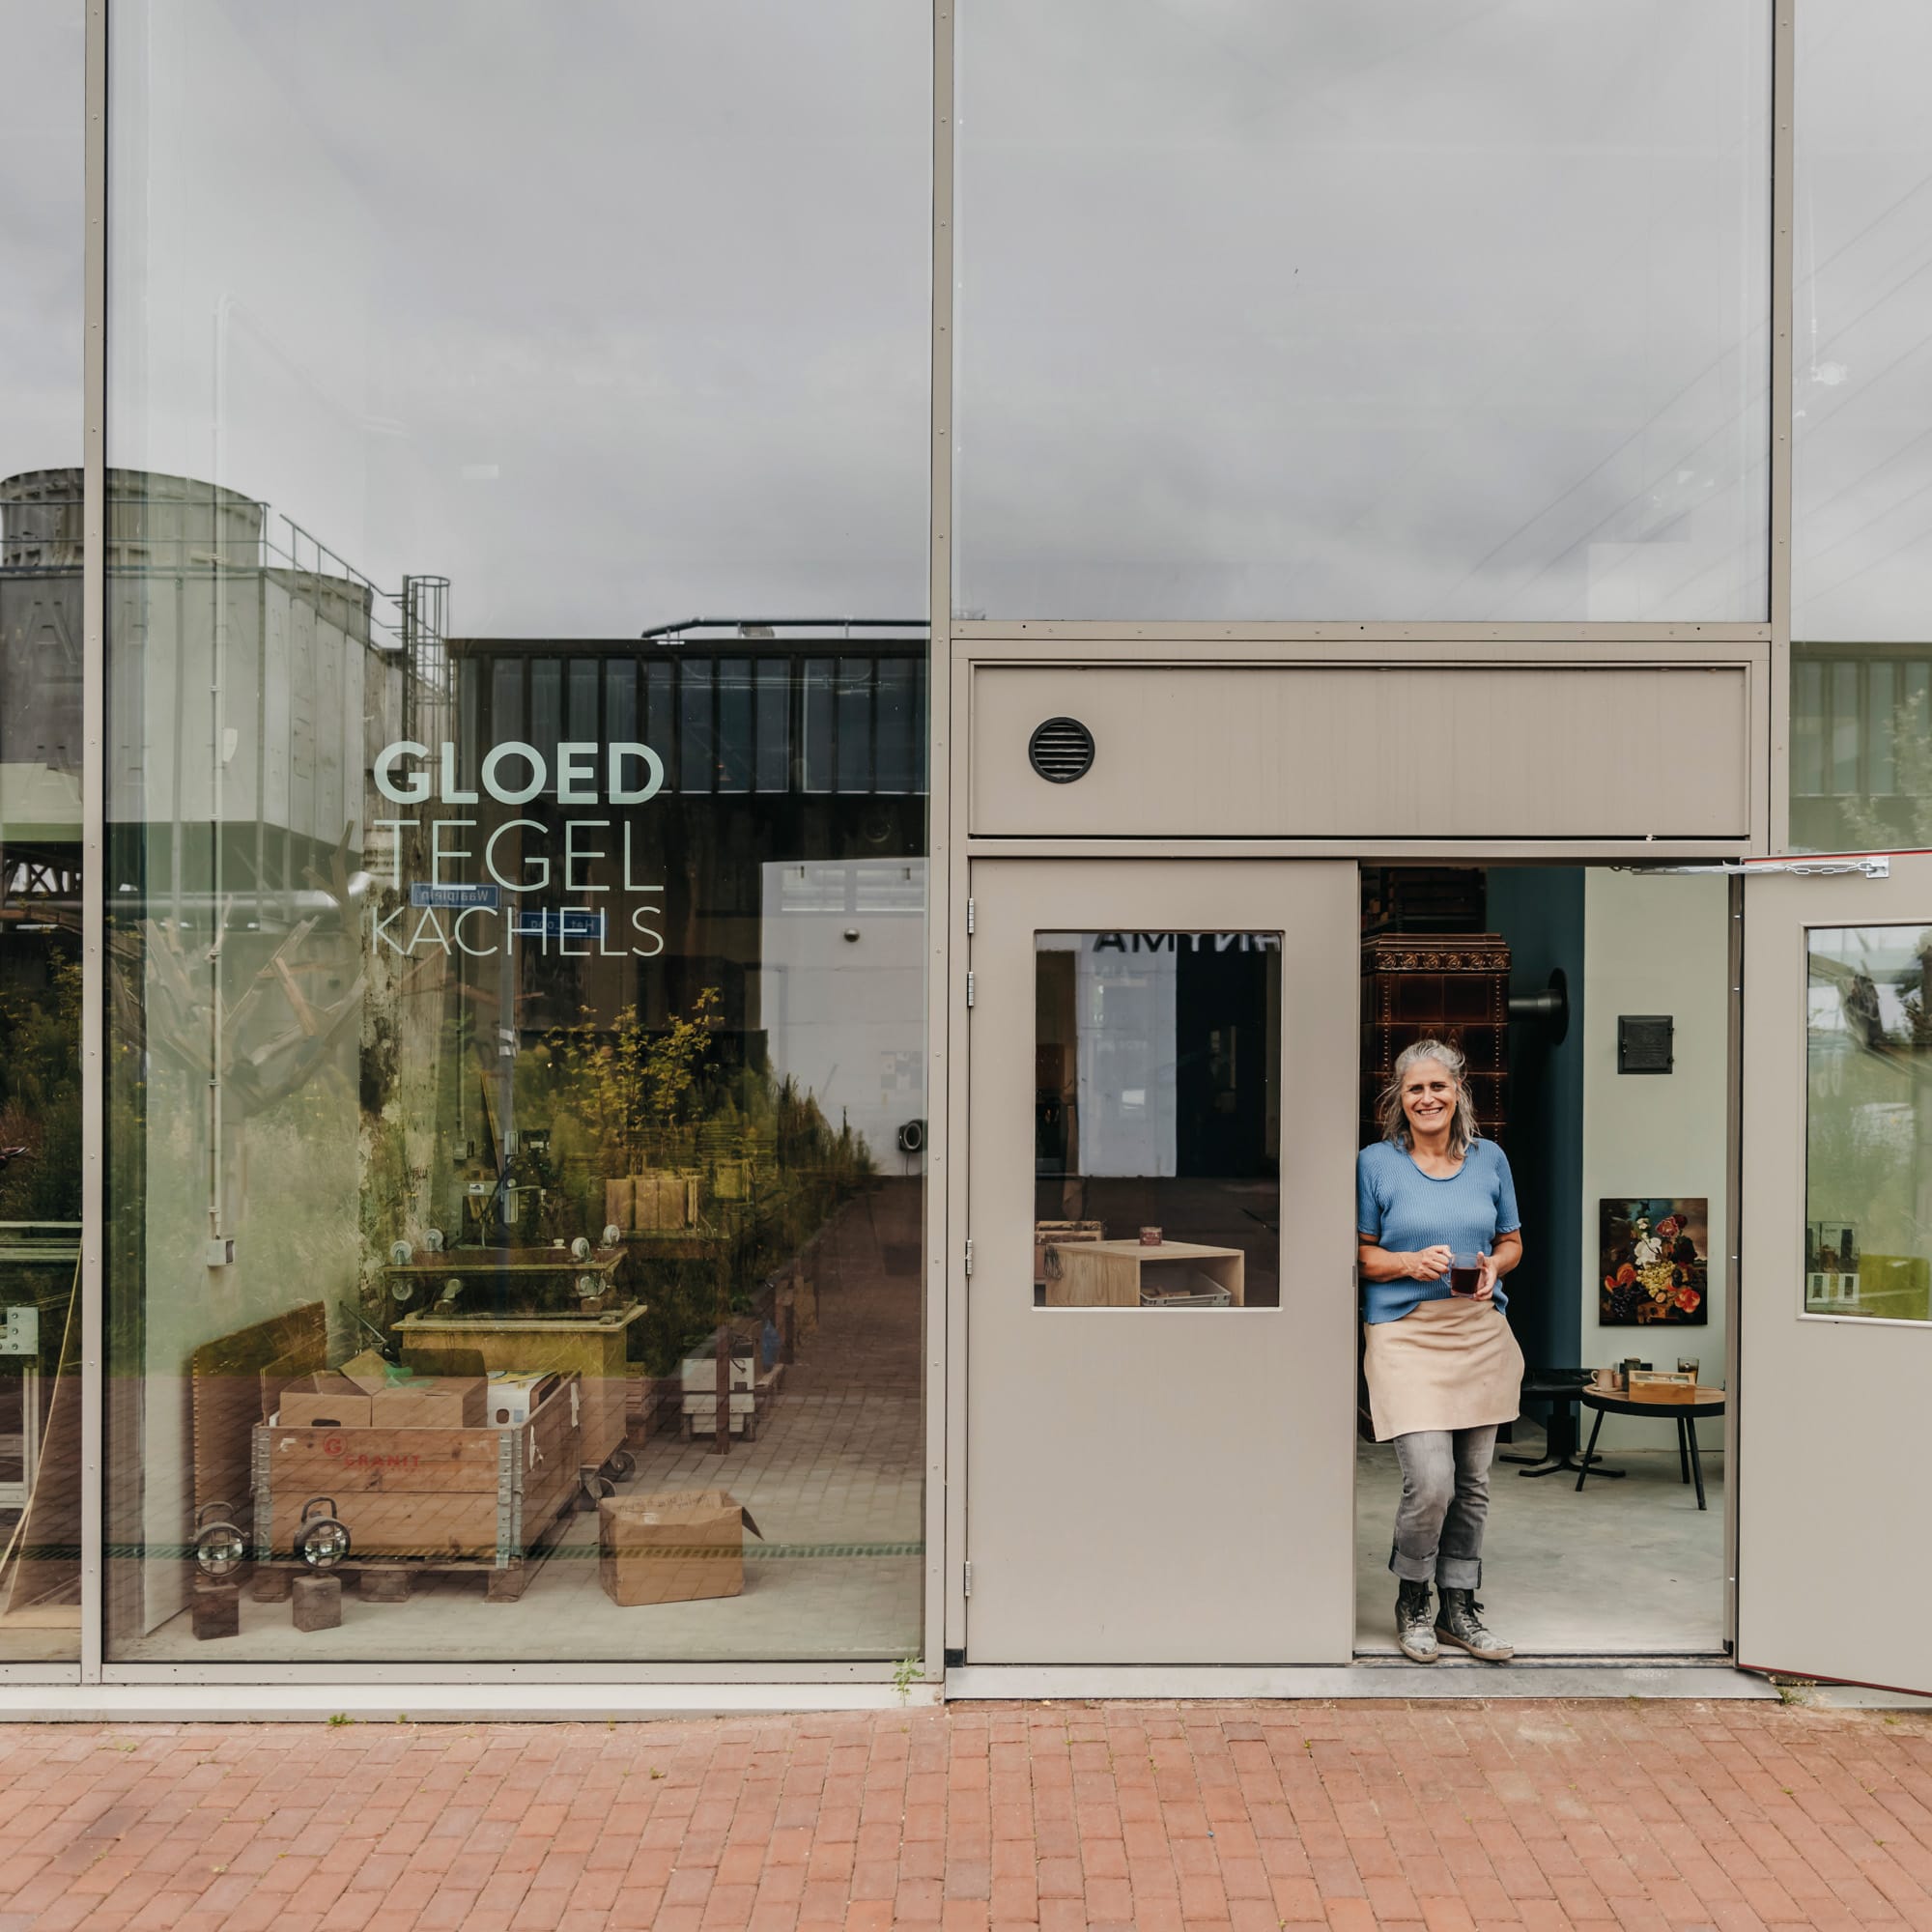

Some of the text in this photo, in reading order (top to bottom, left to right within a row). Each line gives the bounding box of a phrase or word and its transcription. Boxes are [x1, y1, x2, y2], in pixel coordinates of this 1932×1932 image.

[374, 741, 665, 805] GLOED
[374, 819, 665, 892] TEGEL
[372, 906, 665, 957] KACHELS
